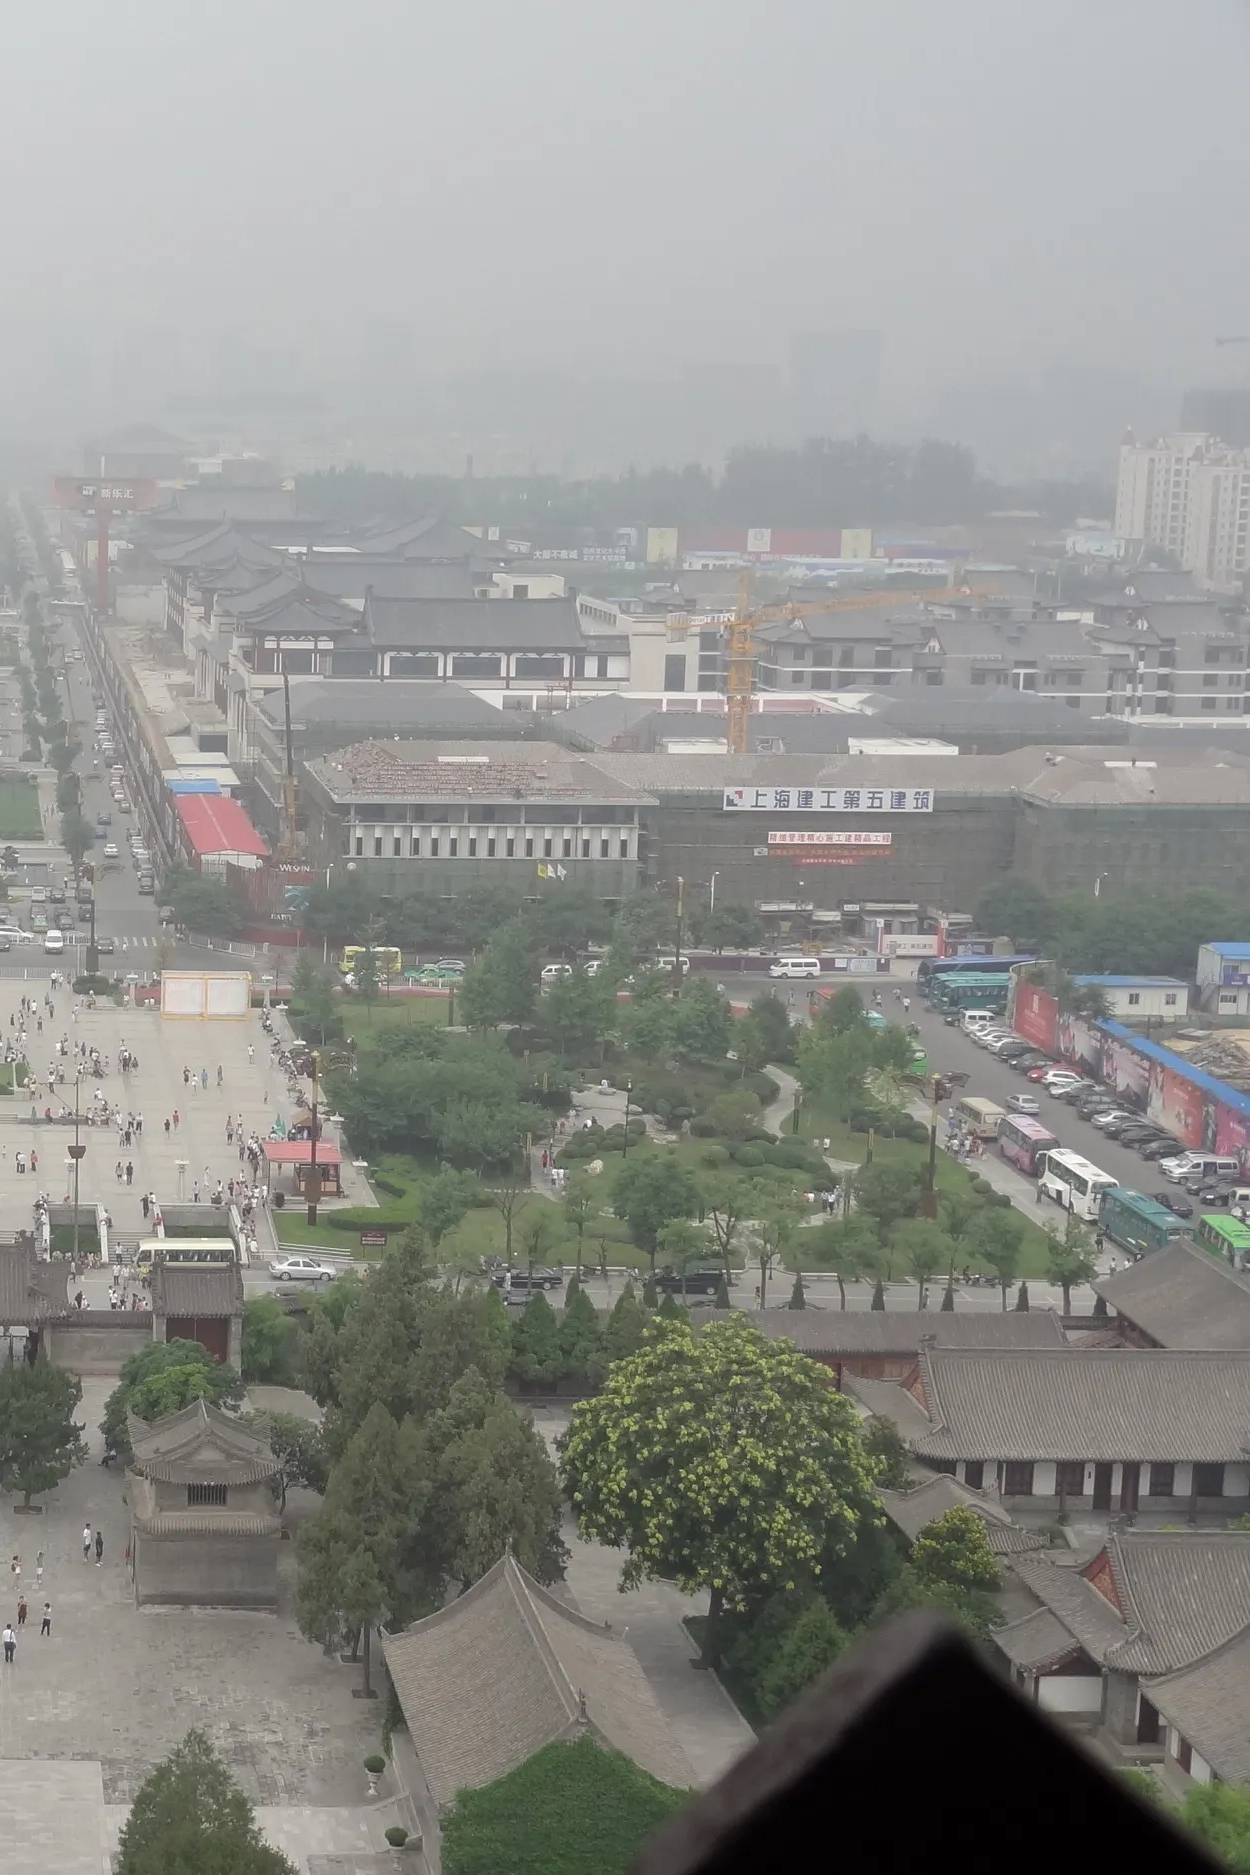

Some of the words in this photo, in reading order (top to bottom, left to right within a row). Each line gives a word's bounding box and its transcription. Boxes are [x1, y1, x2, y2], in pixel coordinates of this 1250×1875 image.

[101, 488, 134, 499] 新乐汇
[750, 789, 931, 810] 上海建工第五建筑
